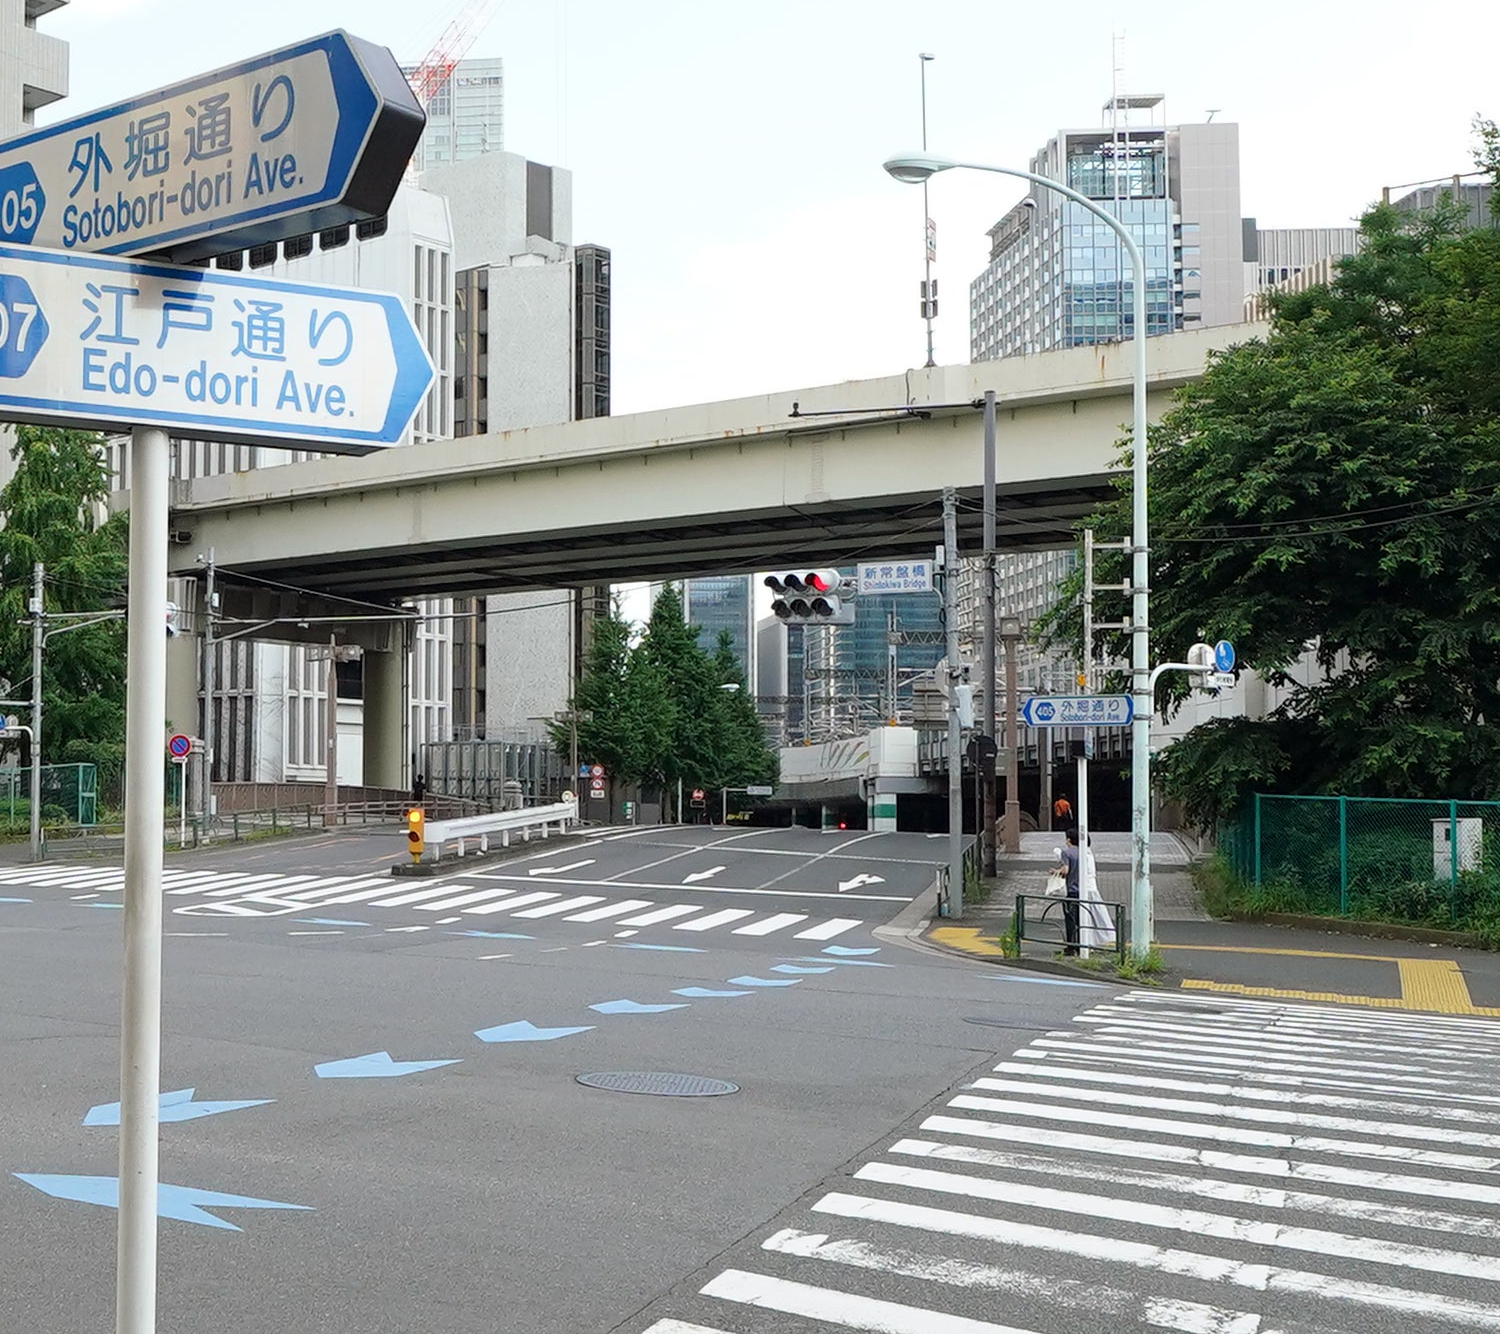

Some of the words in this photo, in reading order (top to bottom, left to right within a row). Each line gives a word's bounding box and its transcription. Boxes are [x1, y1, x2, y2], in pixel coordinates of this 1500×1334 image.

[67, 74, 296, 198] 外堀通り
[62, 166, 233, 251] Sotobori-dori
[243, 152, 303, 201] Ave.
[79, 281, 354, 366] 江戸通り
[82, 349, 259, 408] Edo-dori
[276, 376, 356, 418] Ave.
[864, 564, 926, 579] 新常盤橋
[903, 579, 927, 589] Bridge
[1061, 699, 1120, 713] 外堀通り
